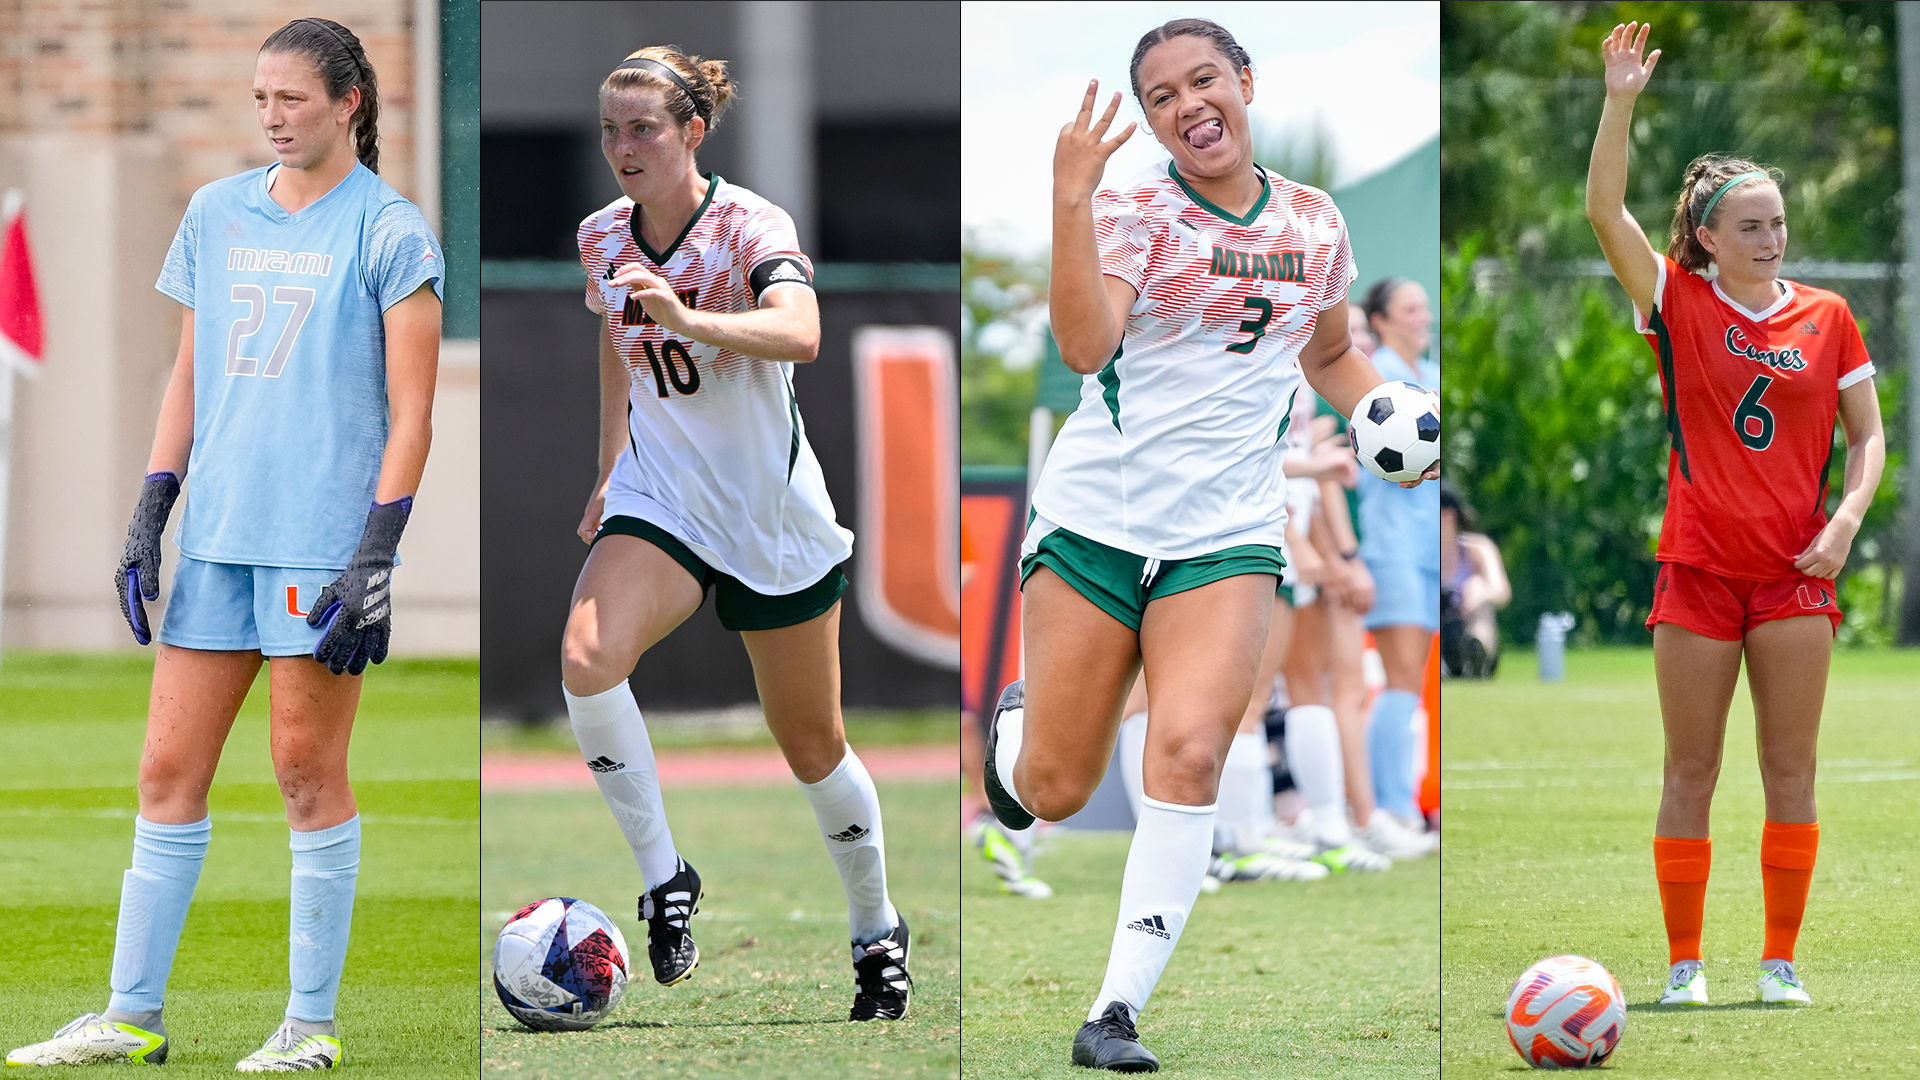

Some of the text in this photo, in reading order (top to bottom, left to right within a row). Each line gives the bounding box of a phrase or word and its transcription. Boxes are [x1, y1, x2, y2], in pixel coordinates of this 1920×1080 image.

[1208, 243, 1306, 284] MIAMI
[225, 284, 316, 379] 27
[1225, 295, 1274, 355] 3
[1725, 324, 1808, 372] Canes
[643, 339, 701, 399] 10
[1733, 374, 1775, 452] 6
[828, 828, 870, 843] adidas
[1127, 921, 1171, 940] adidas
